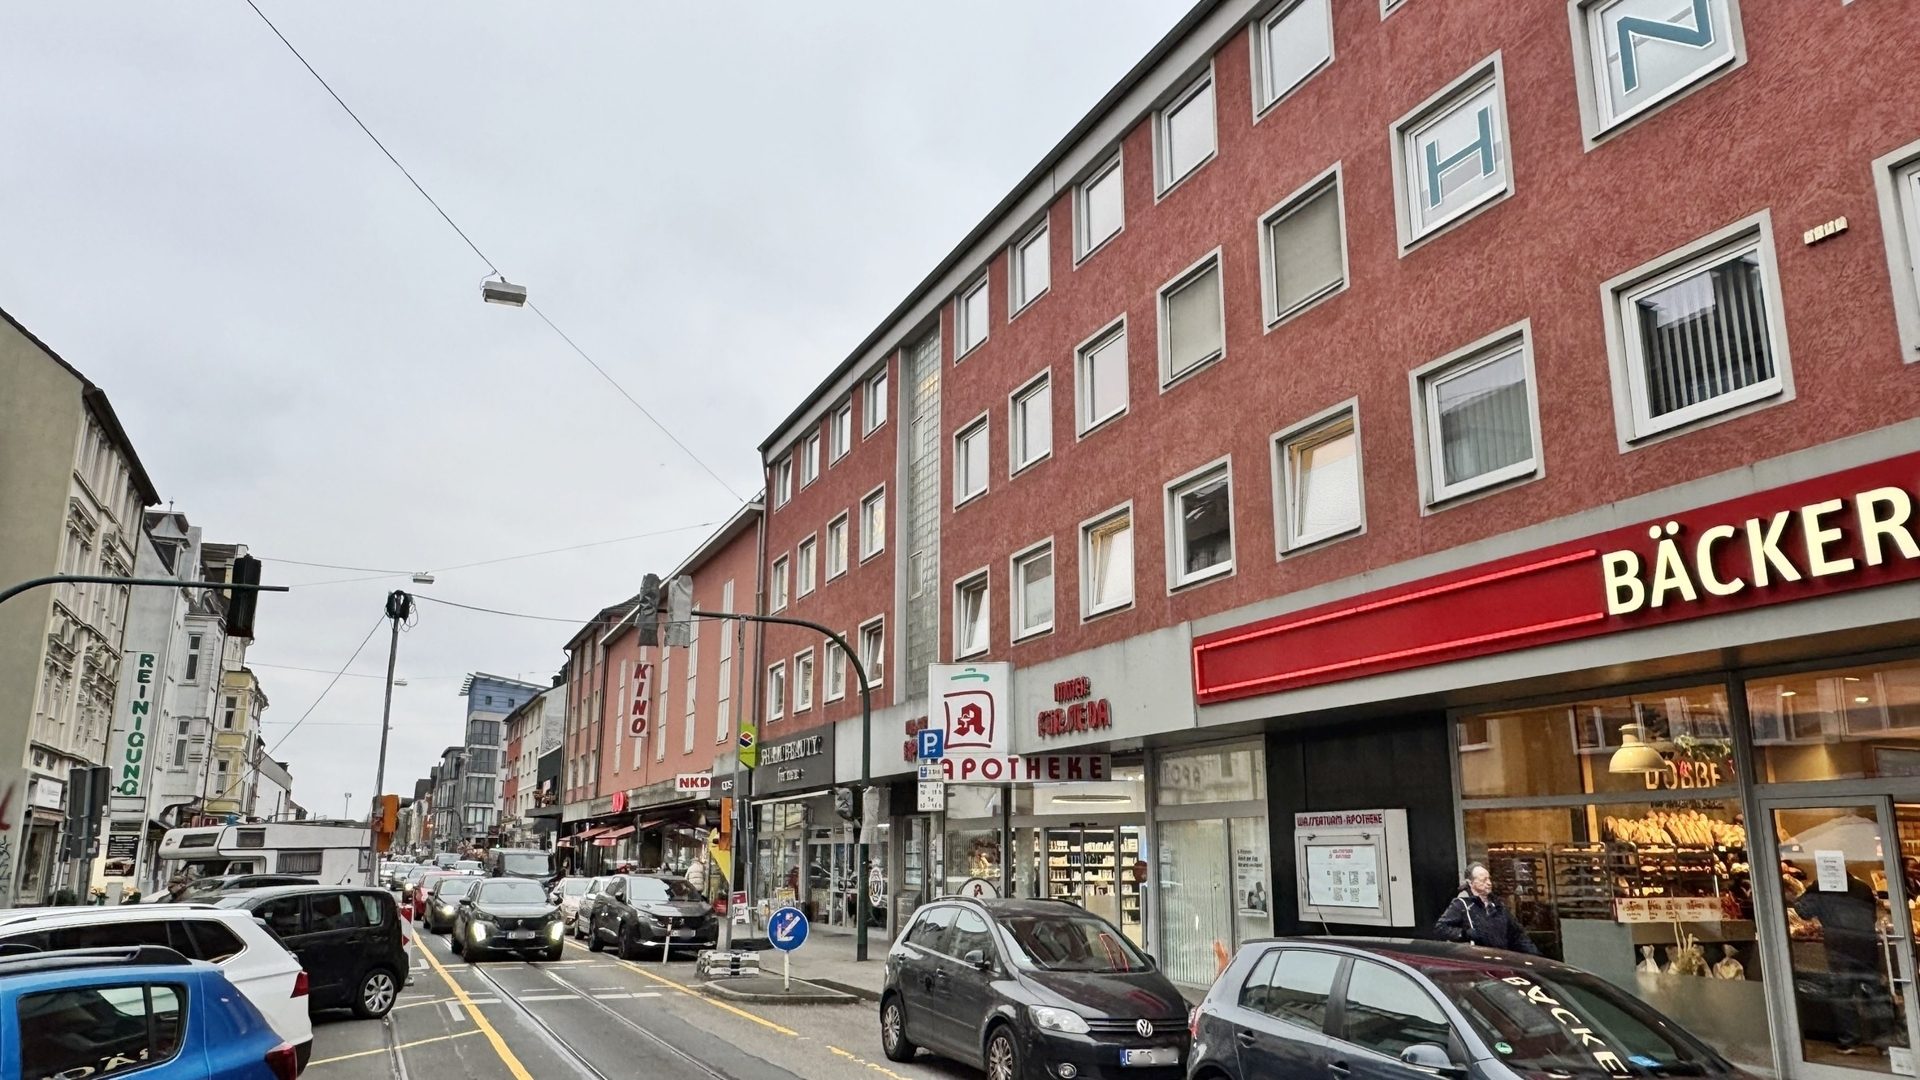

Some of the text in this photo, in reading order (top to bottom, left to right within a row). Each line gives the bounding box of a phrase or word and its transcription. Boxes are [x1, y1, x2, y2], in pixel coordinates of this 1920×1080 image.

[1602, 487, 1920, 616] BÄCKER
[631, 663, 649, 735] KINO
[121, 653, 154, 796] REINIGUNG
[924, 733, 938, 755] P
[679, 777, 710, 789] NKD
[942, 757, 1102, 780] APOTHEKE
